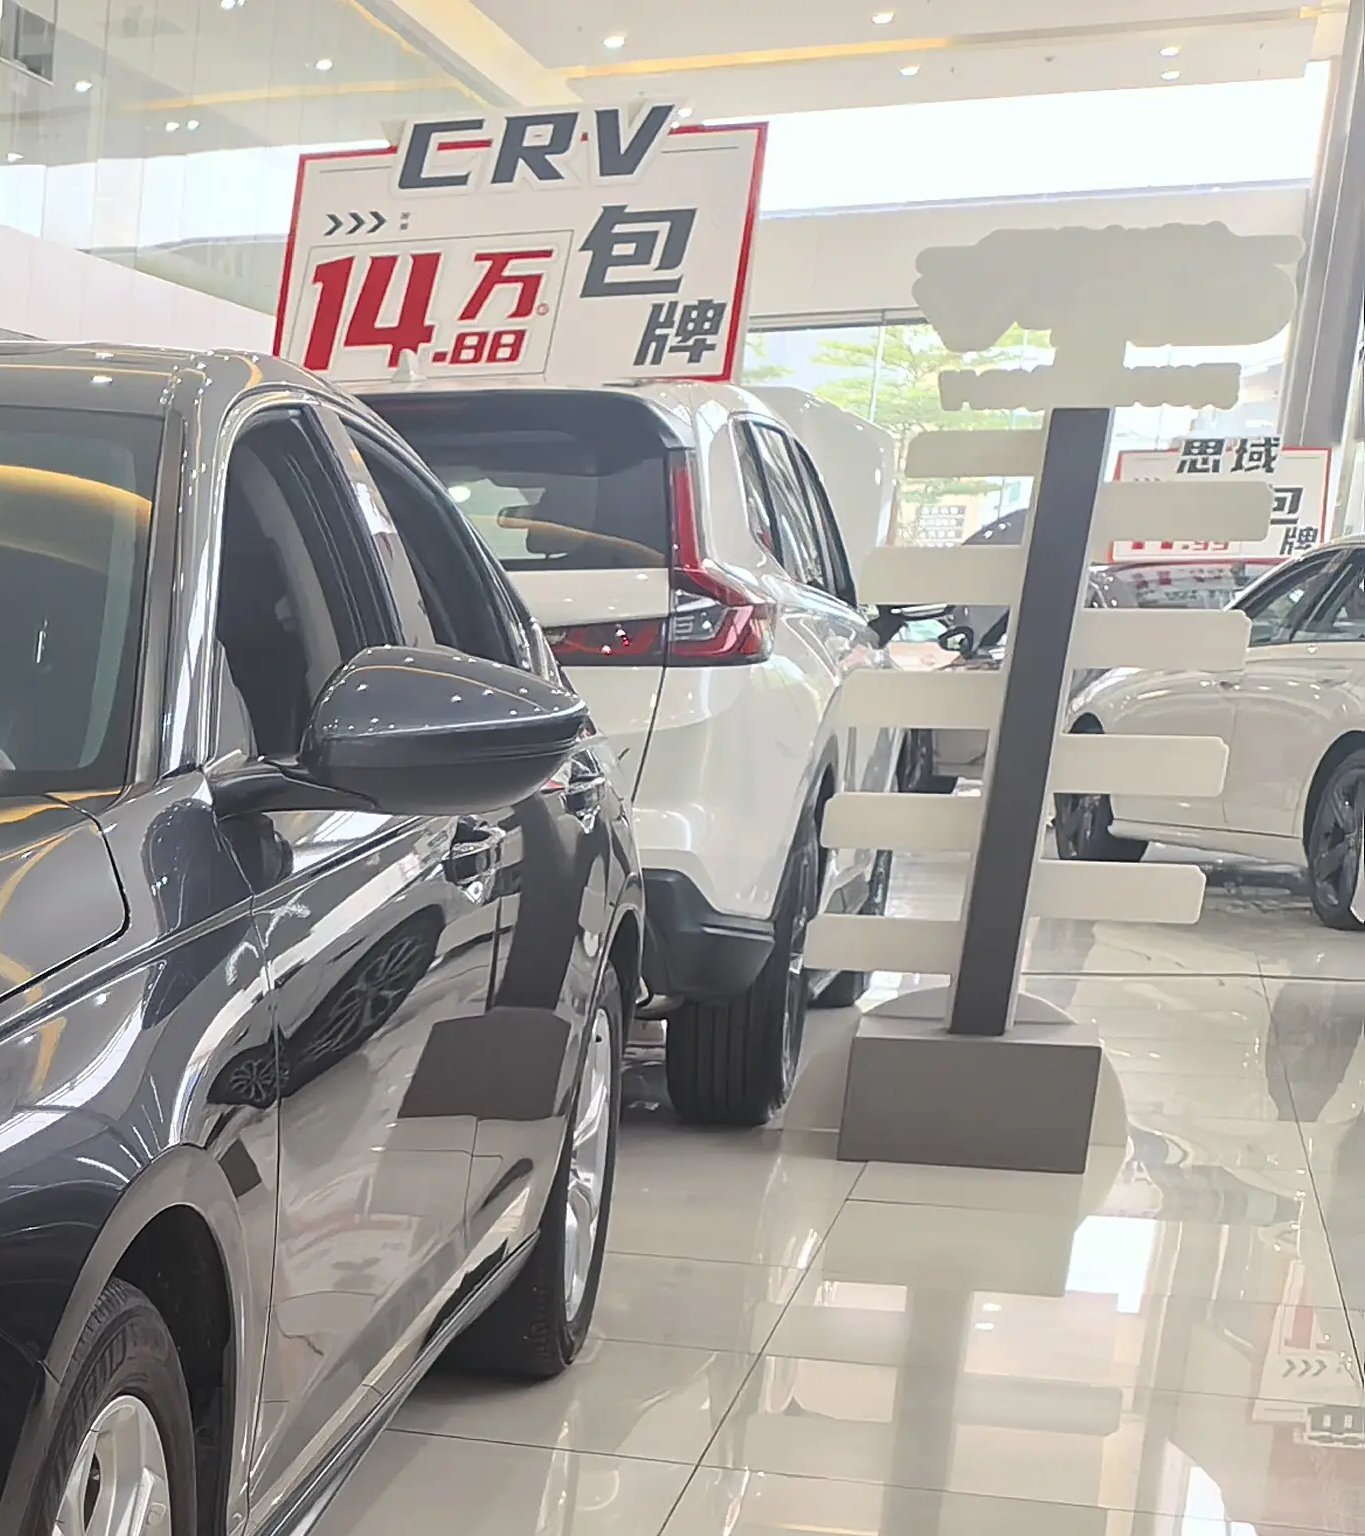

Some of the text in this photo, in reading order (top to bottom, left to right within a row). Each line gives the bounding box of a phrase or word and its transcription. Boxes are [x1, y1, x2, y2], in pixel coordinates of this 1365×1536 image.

[398, 104, 675, 189] CRV
[302, 252, 442, 371] 14
[1177, 437, 1280, 474] 思域
